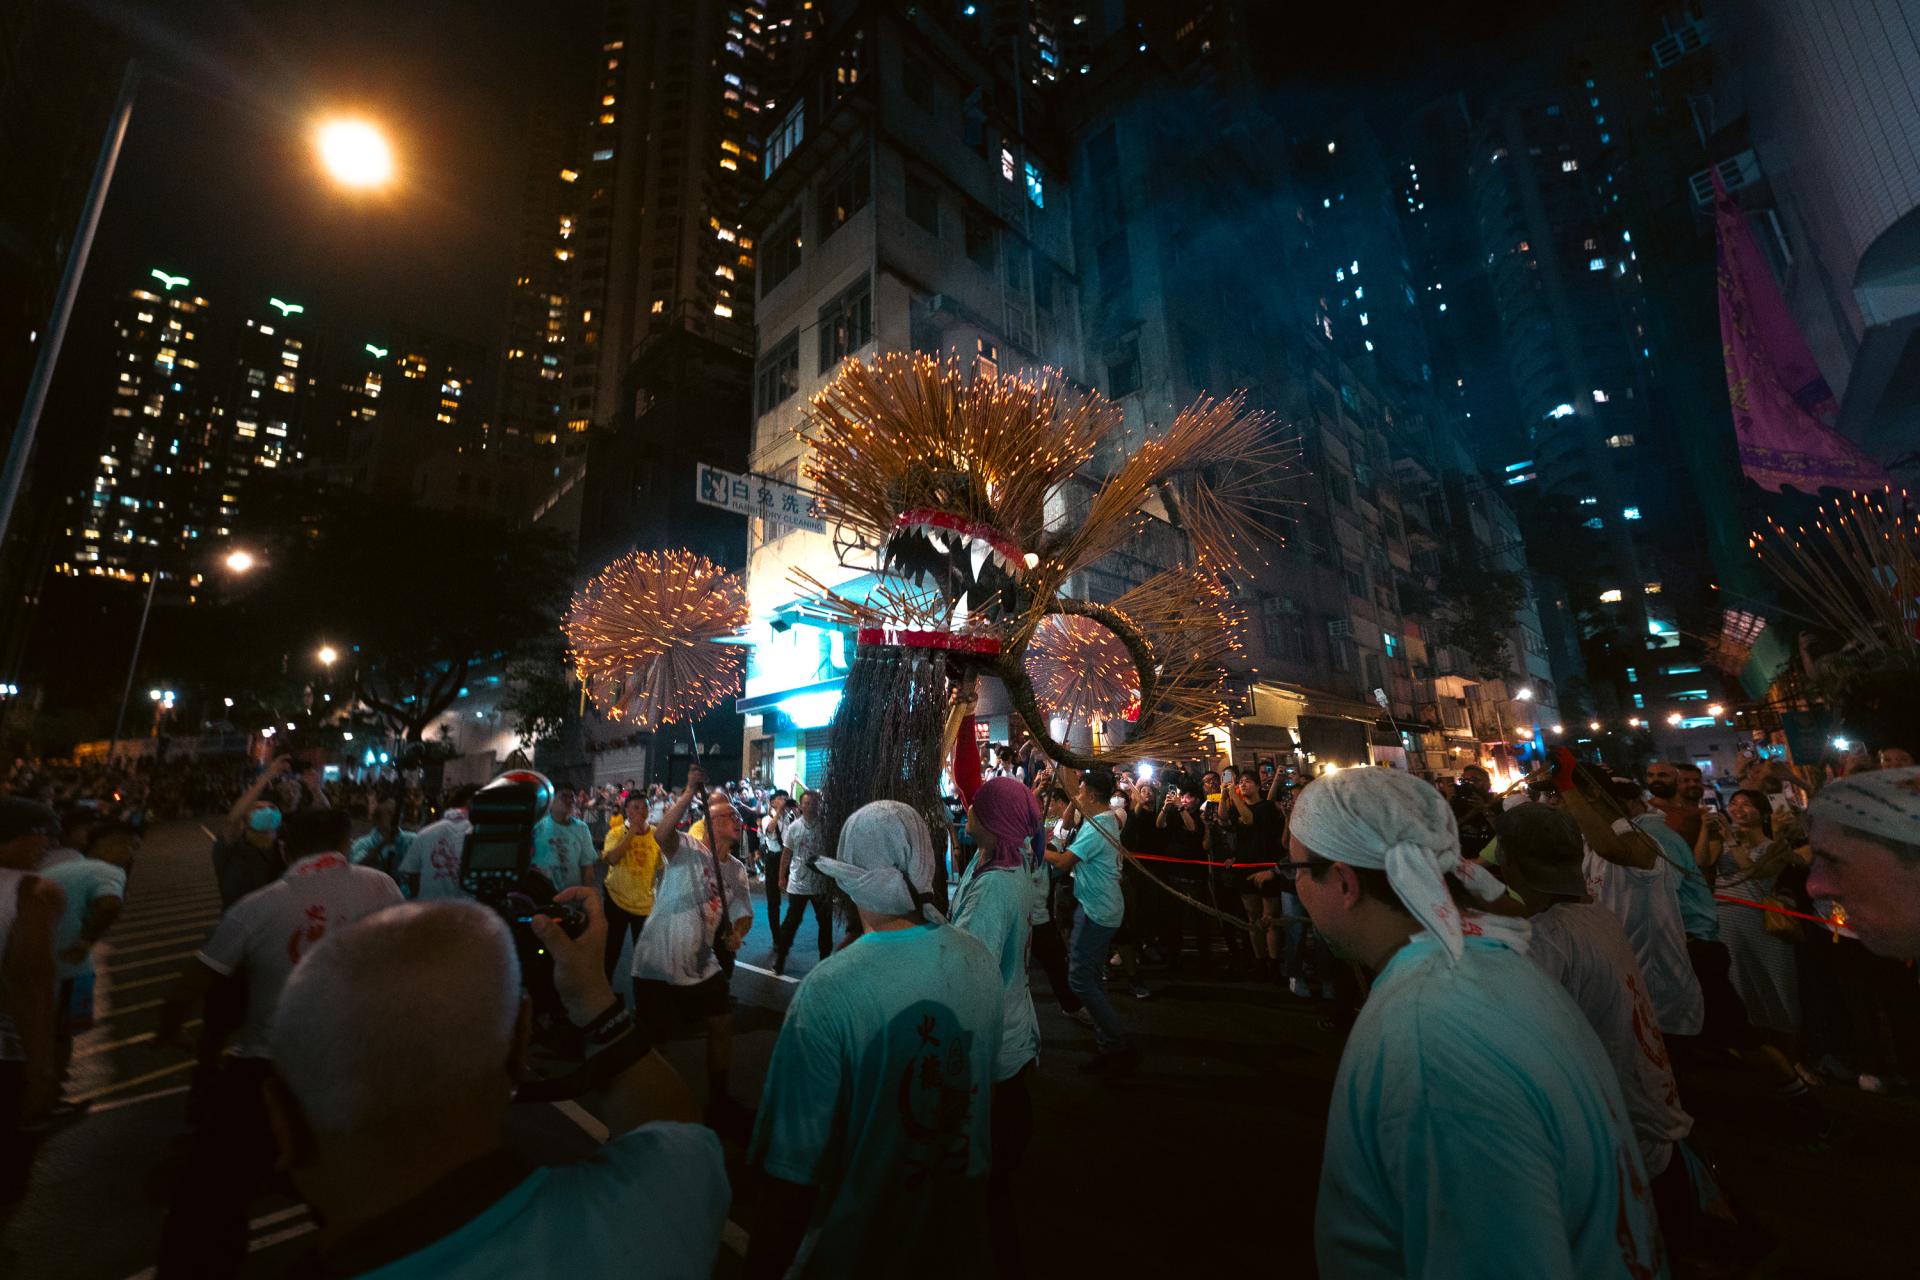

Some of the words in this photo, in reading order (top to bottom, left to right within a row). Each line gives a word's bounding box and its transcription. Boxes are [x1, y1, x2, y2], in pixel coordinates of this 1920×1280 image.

[732, 501, 763, 516] RABBI
[765, 511, 781, 520] DRY
[783, 514, 823, 531] CLEANING
